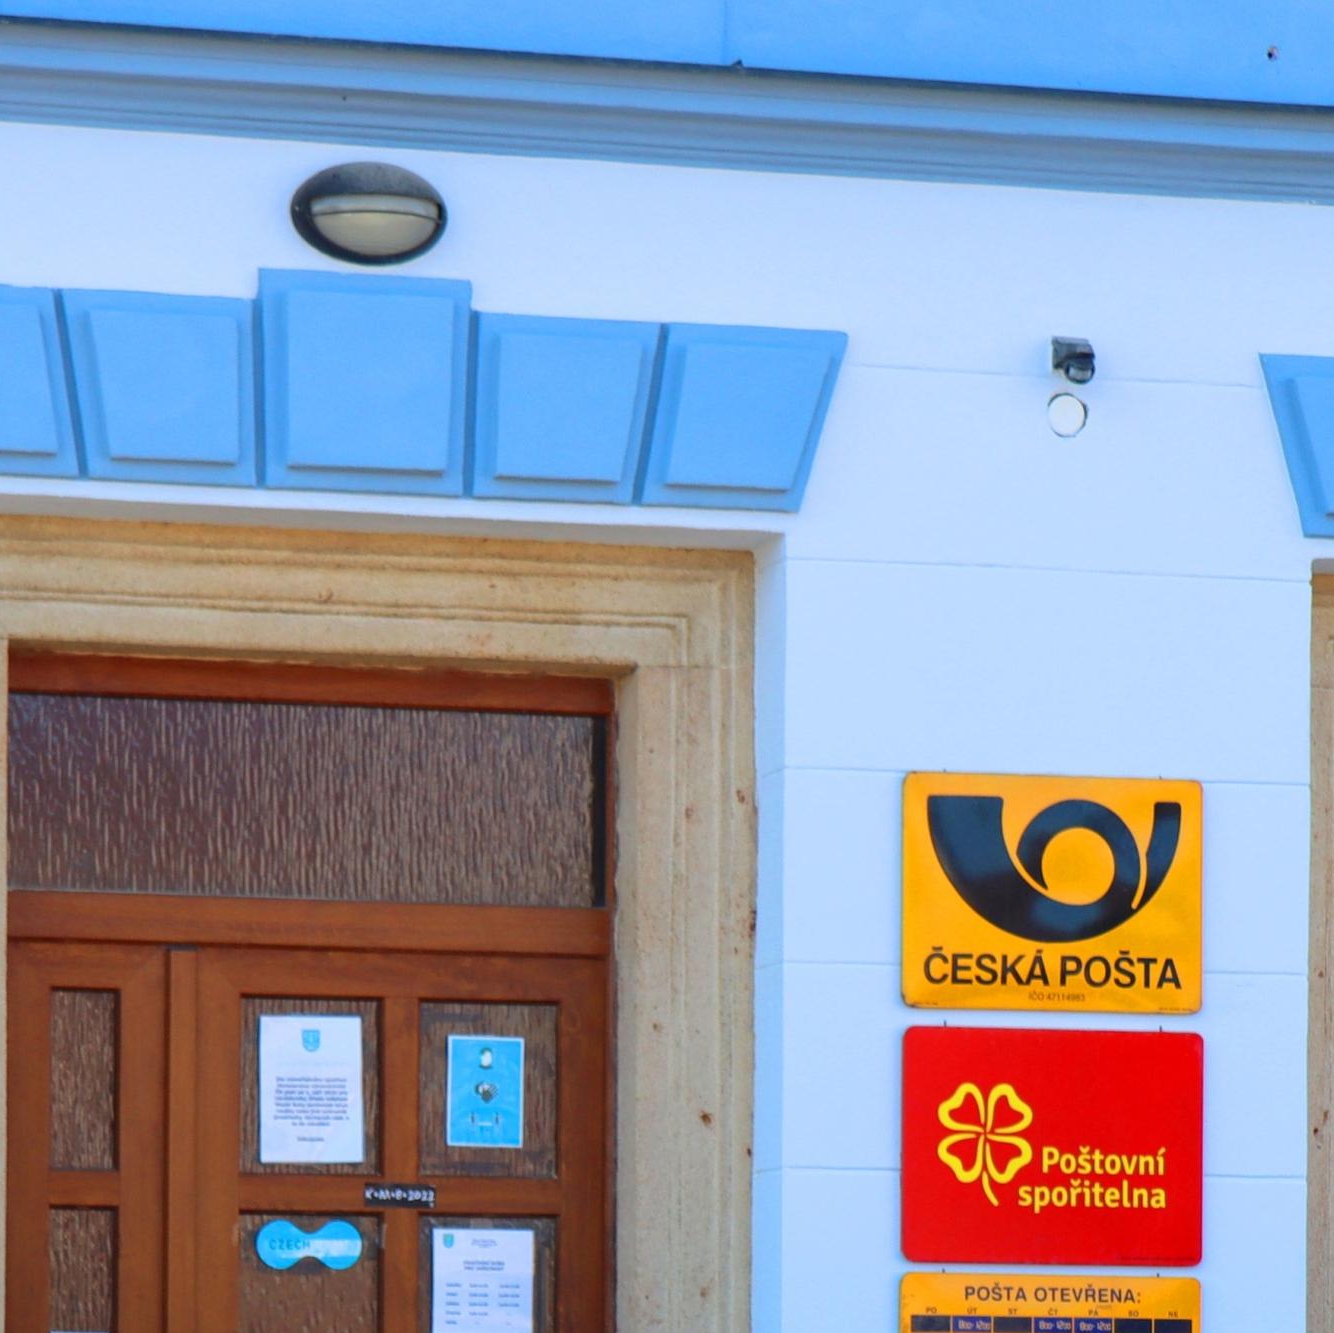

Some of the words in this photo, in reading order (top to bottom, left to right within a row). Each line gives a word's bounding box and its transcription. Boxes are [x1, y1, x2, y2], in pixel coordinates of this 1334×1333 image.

[923, 946, 1050, 987] ČESKÁ
[1059, 950, 1183, 990] POŠTA
[1042, 1145, 1167, 1176] Poštovní
[1018, 1178, 1167, 1215] spořitelna
[964, 1283, 1028, 1302] POŠTA
[1033, 1283, 1142, 1304] OTEVŘENA:
